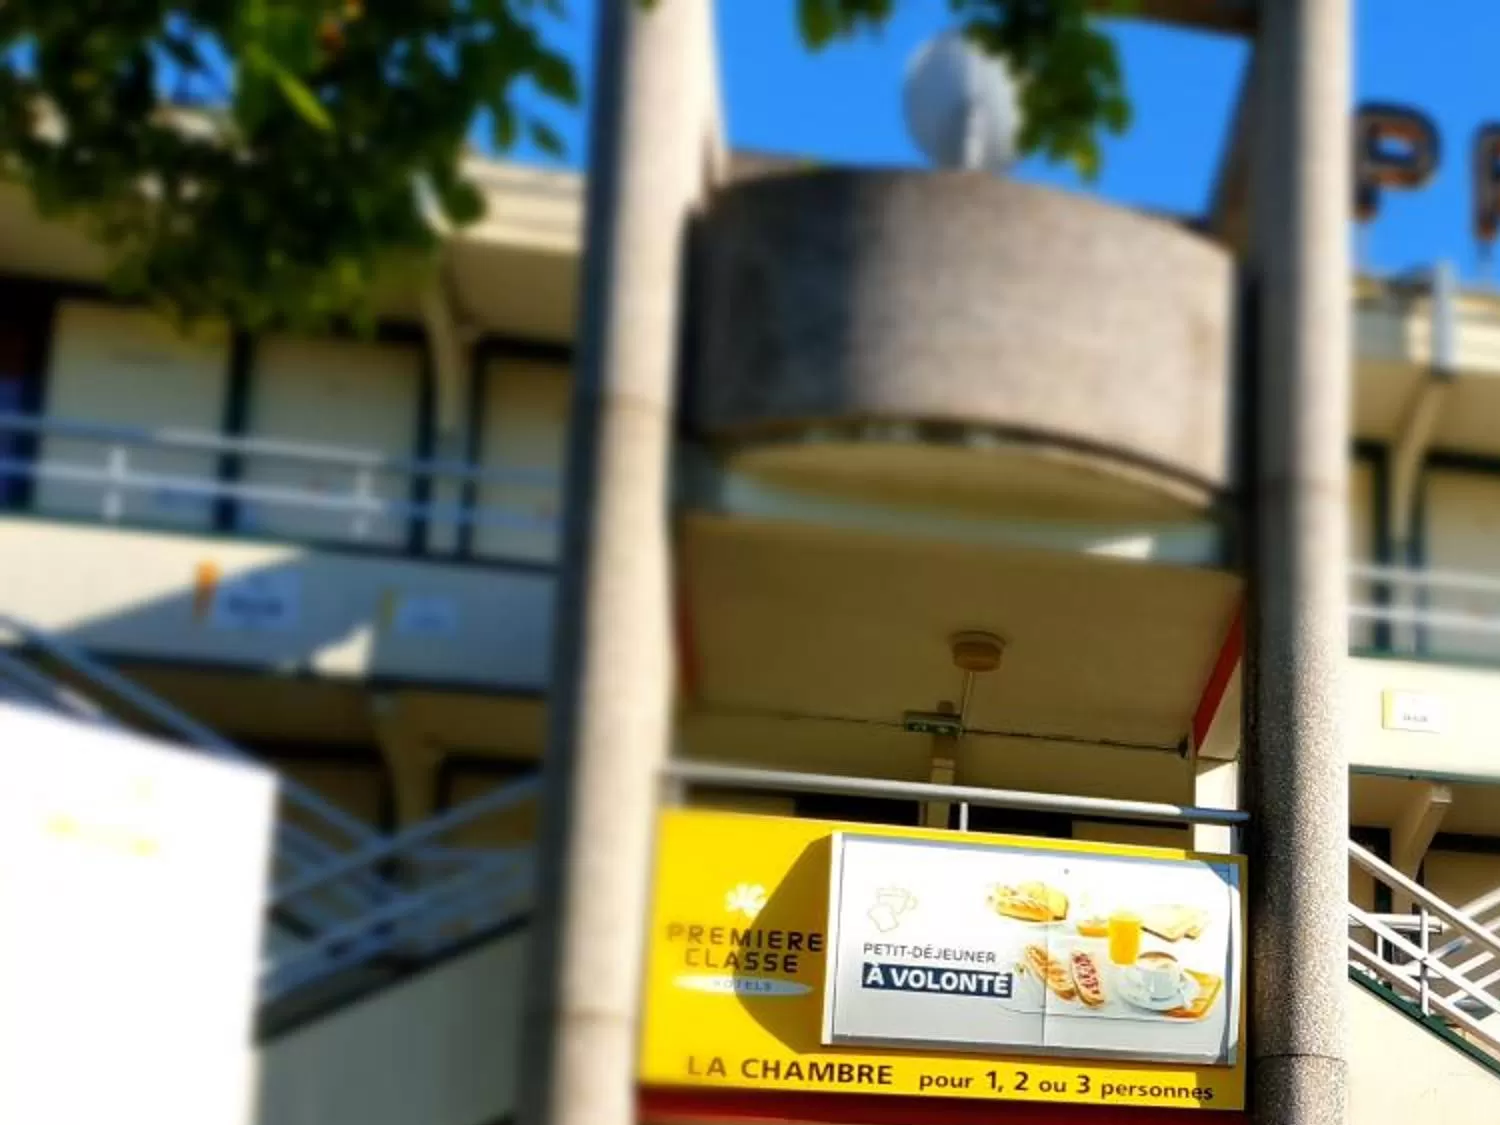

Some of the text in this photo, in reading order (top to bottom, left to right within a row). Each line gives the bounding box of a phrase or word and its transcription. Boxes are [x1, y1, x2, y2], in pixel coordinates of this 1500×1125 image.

[665, 922, 824, 952] PREMIERE
[684, 948, 799, 973] CLASSE
[863, 942, 996, 963] PETIT-DÉJEUNER
[686, 1055, 1214, 1101] LA CHAMBRE pour 1, 2 ou 3 personnes
